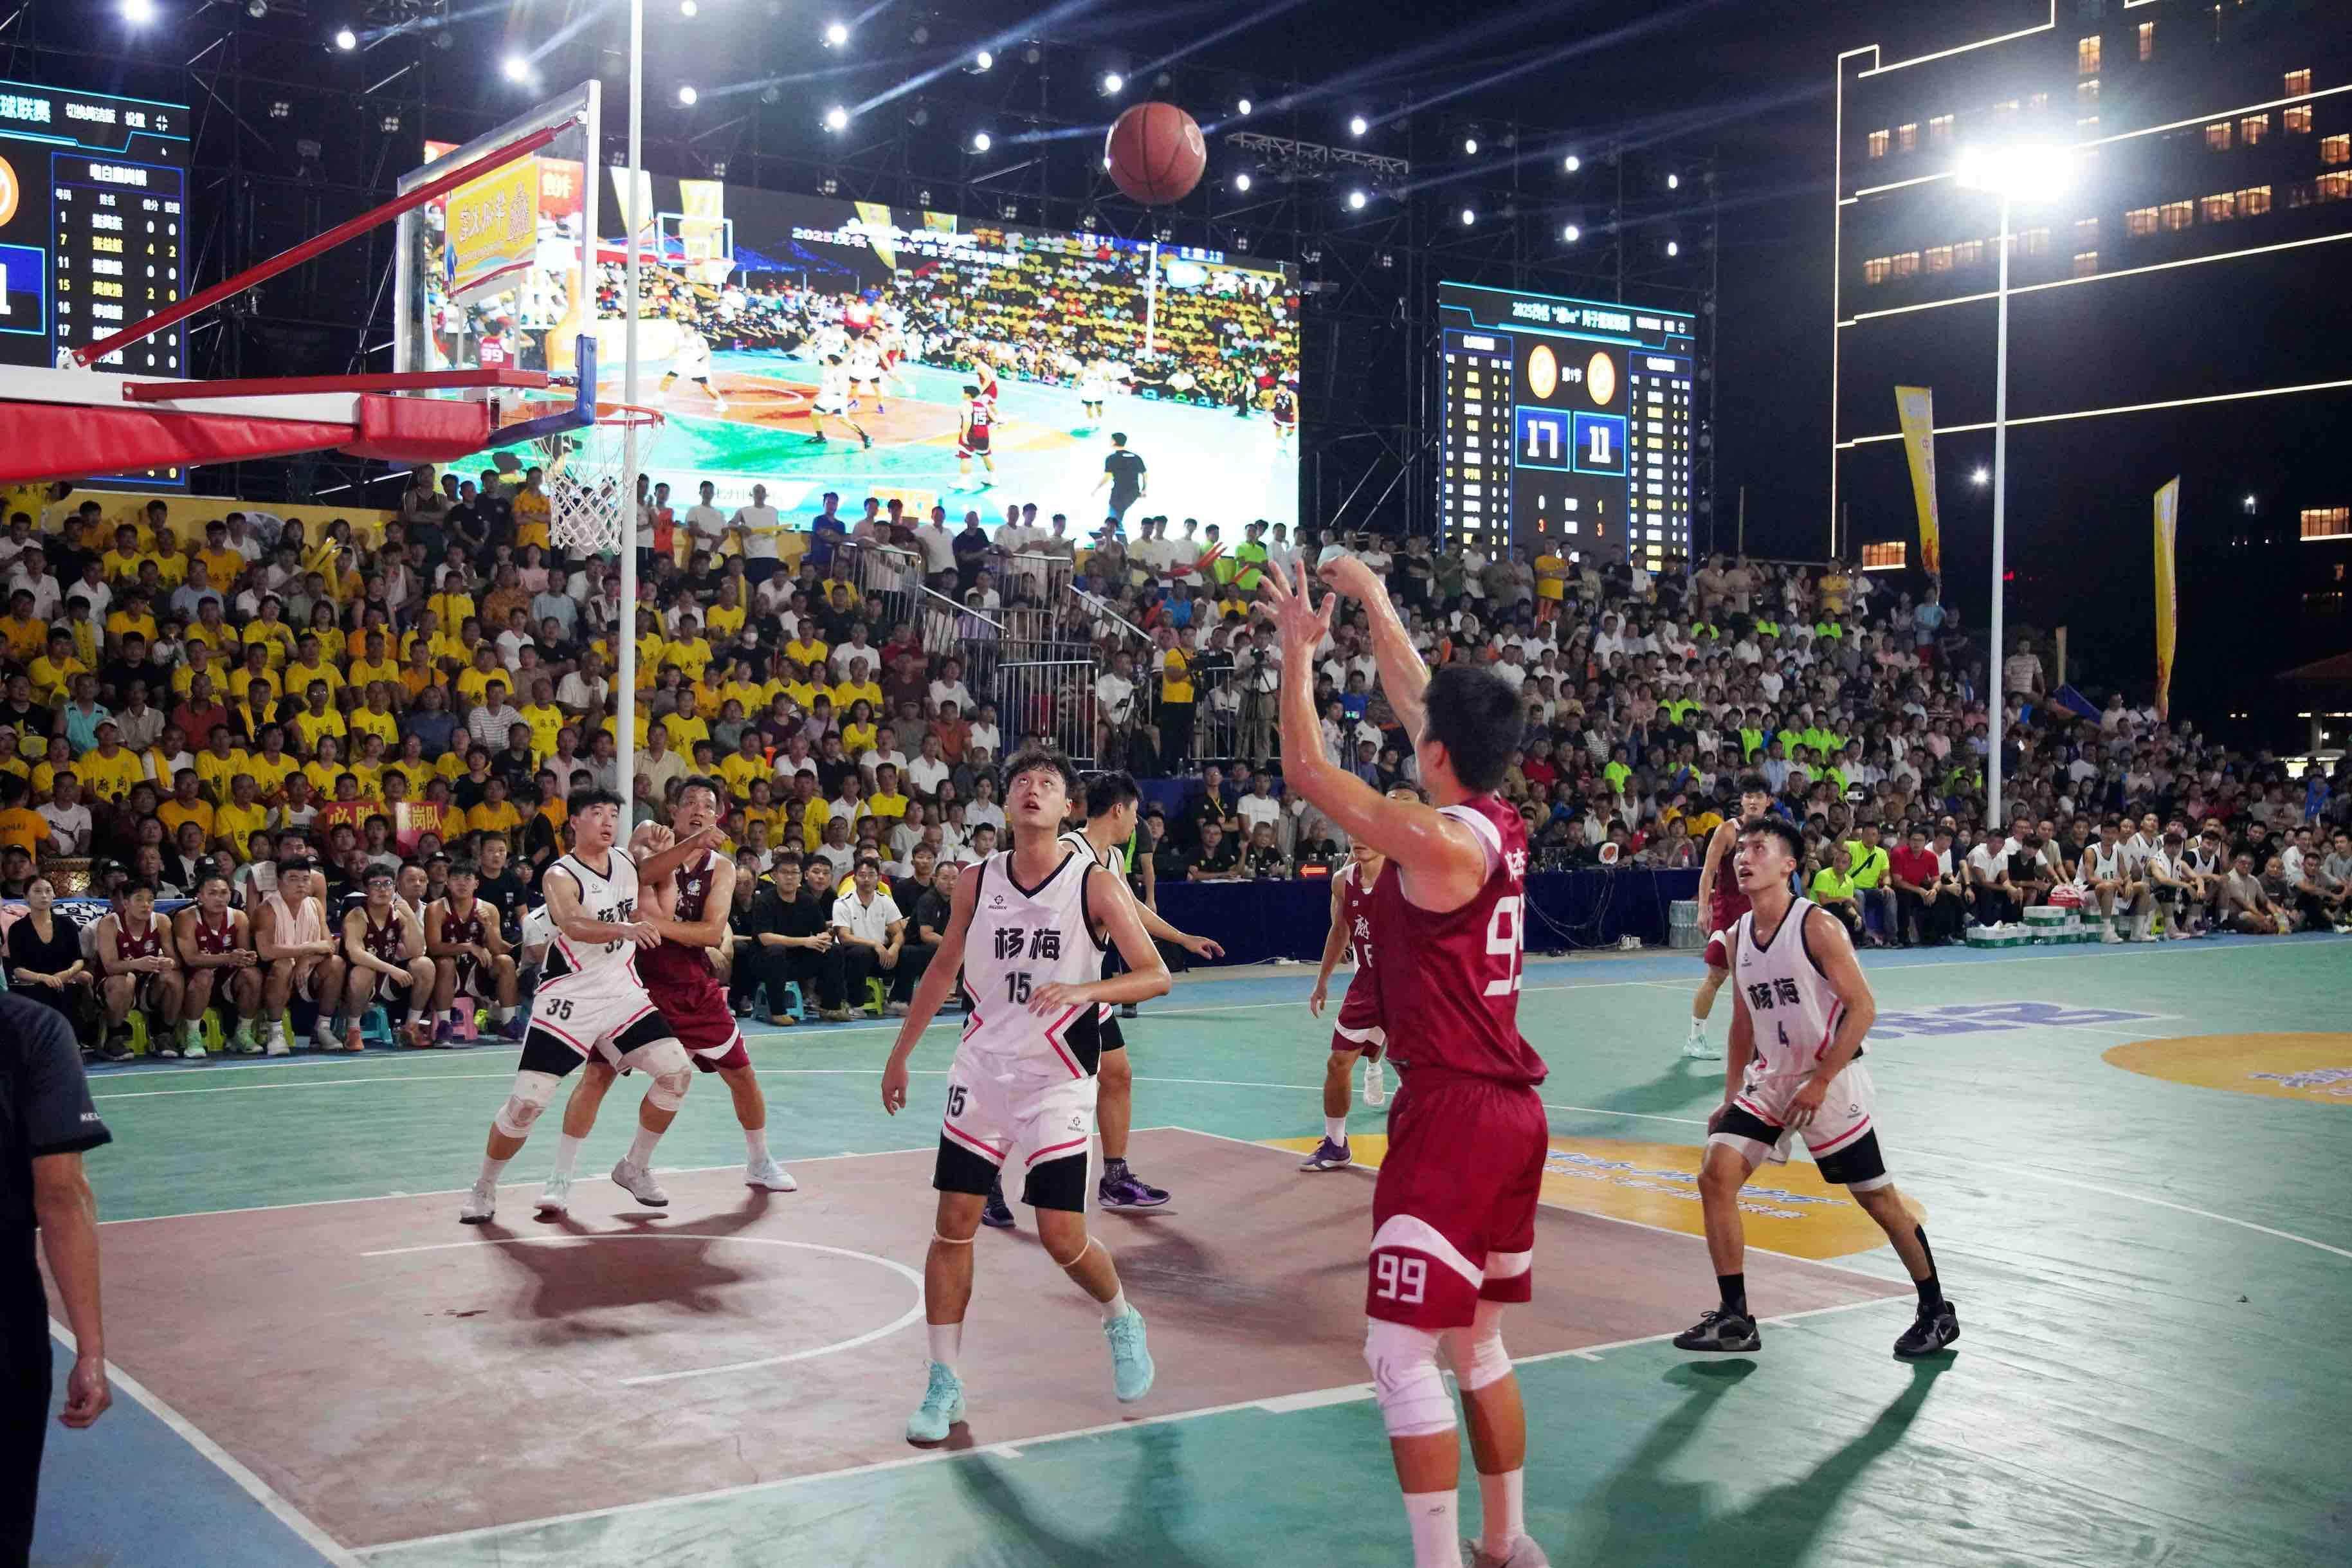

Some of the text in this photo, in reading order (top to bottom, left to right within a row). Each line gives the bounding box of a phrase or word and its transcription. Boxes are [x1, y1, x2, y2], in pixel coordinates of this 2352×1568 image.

[60, 211, 176, 236] 1 0 0
[60, 233, 68, 245] 7
[147, 243, 154, 255] 4
[169, 245, 176, 257] 2
[58, 255, 176, 280] 11 0 0
[58, 278, 176, 302] 15 2 0
[58, 301, 70, 314] 16
[58, 324, 177, 347] 17 0 0
[147, 354, 155, 367] 0
[169, 356, 177, 369] 0
[1527, 419, 1558, 459] 17
[1589, 425, 1611, 464] 11
[1538, 495, 1603, 514] 0 1
[1538, 518, 1603, 537] 3 3
[994, 927, 1061, 960] 杨梅
[1482, 893, 1525, 996] 9
[1005, 971, 1032, 1005] 15
[1747, 978, 1801, 1010] 杨梅
[546, 998, 574, 1021] 35
[1777, 1020, 1790, 1048] 4
[946, 1083, 968, 1118] 15
[1376, 1254, 1428, 1304] 99
